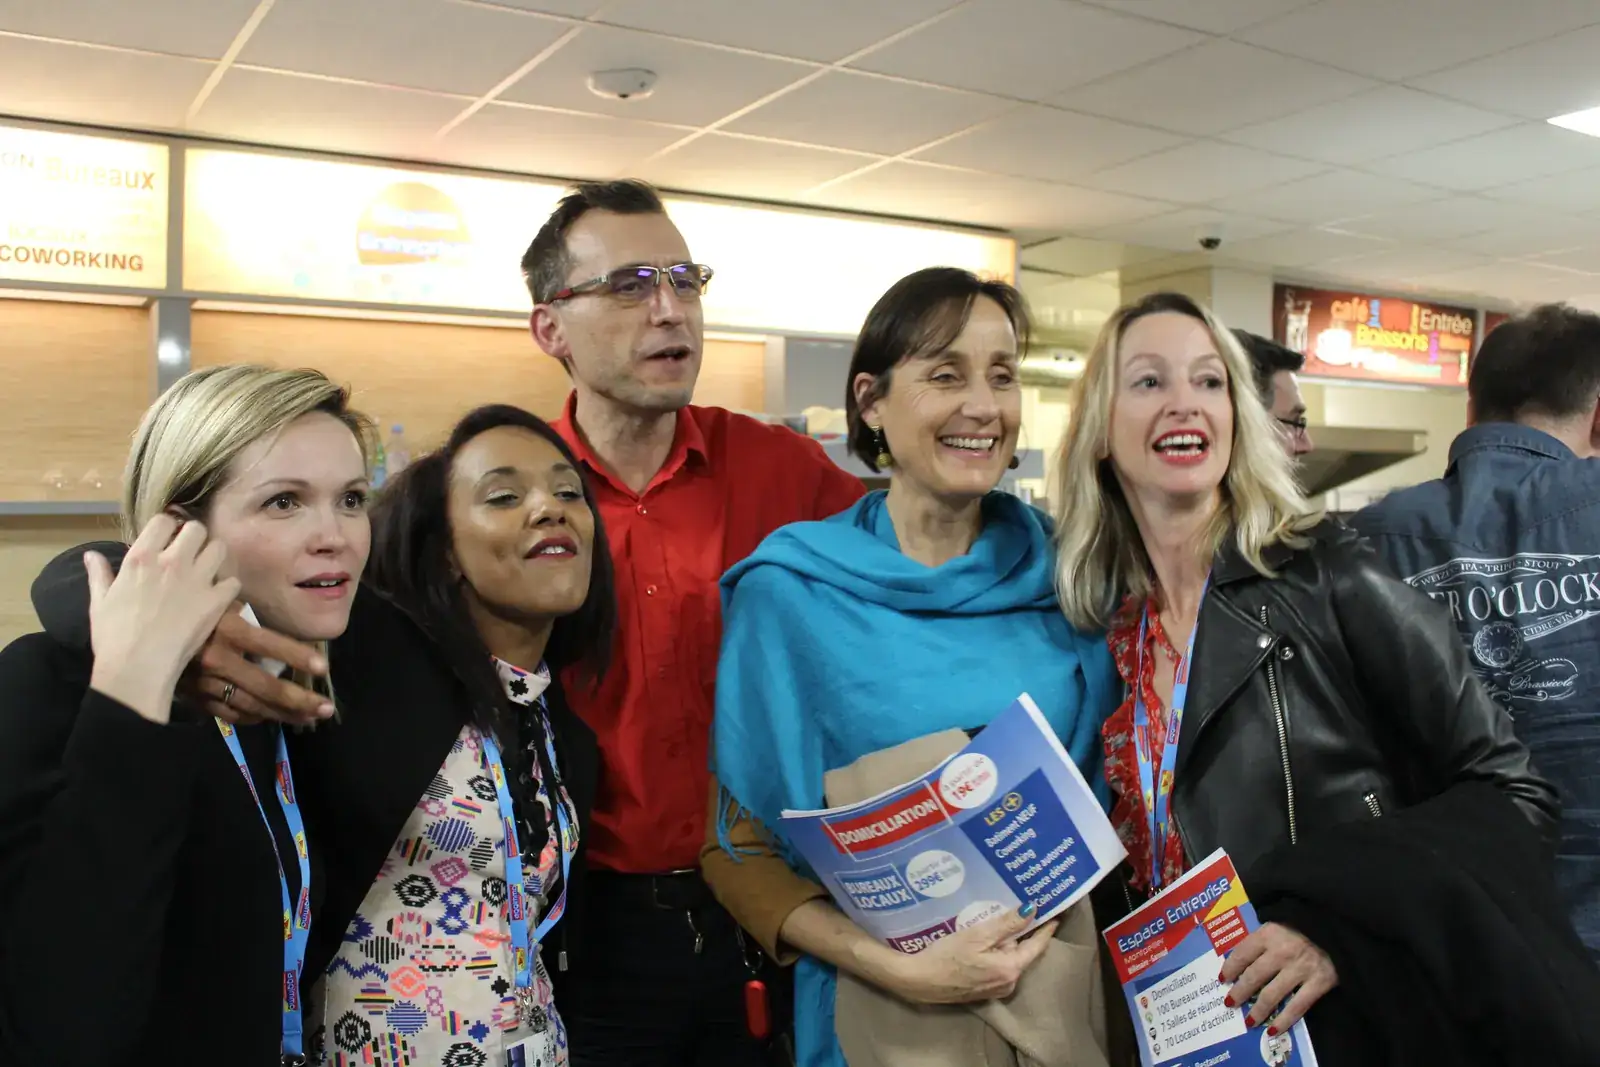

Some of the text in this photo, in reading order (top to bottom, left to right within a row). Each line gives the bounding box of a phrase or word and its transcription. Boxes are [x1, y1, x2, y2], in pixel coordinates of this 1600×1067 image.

[0, 244, 144, 272] COWORKING
[1331, 297, 1369, 322] café
[1420, 308, 1473, 335] Entrée
[1357, 323, 1429, 352] Boissons
[1460, 563, 1479, 572] IPA
[1524, 558, 1561, 571] STOUT
[1468, 572, 1600, 621] O'CLOCK
[838, 798, 940, 845] DOMICILIATION
[984, 807, 1006, 826] LES
[995, 828, 1037, 858] Coworking
[1004, 849, 1037, 872] Parking
[1015, 836, 1075, 884] Proche autoroute
[844, 875, 901, 894] BUREAUX
[914, 871, 944, 891] 299€
[1024, 855, 1077, 896] Espace détente
[853, 889, 913, 909] LOCAUX
[1034, 875, 1077, 907] Coin cuisine
[1118, 877, 1229, 953] Espace Entreprise
[900, 930, 947, 953] ESPACE
[1151, 972, 1197, 1001] Domiciliation
[1157, 1002, 1171, 1016] 100
[1170, 990, 1199, 1010] Bureaux
[1165, 1008, 1236, 1049] 70 Locaux d'activité
[1166, 1014, 1188, 1031] Salles
[1187, 1008, 1198, 1021] de
